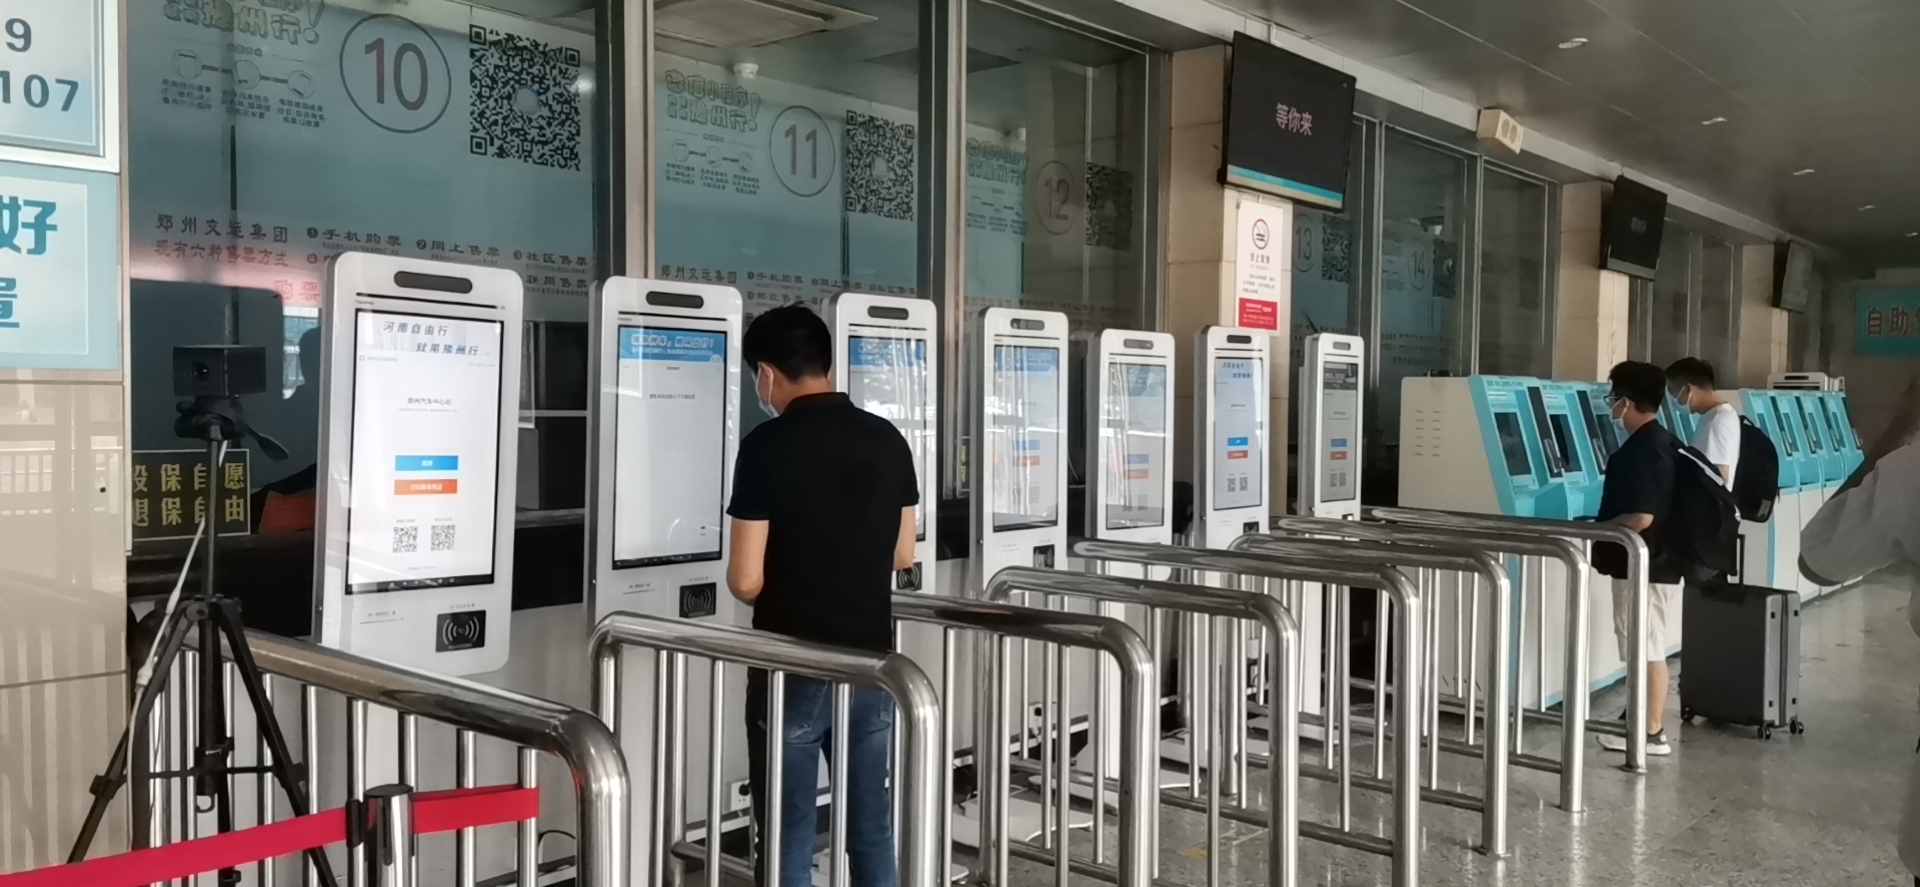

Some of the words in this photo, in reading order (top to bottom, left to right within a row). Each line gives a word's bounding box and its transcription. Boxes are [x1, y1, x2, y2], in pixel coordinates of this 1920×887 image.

[5, 18, 32, 53] 9
[364, 37, 428, 111] 10
[1275, 102, 1313, 136] 等你来
[784, 124, 817, 180] 11
[1044, 176, 1070, 222] 12
[155, 239, 288, 268] 现有六种售票方式
[322, 229, 402, 247] 手机购票
[383, 321, 448, 336] 河南自由行
[416, 342, 478, 356] 就用豫州行
